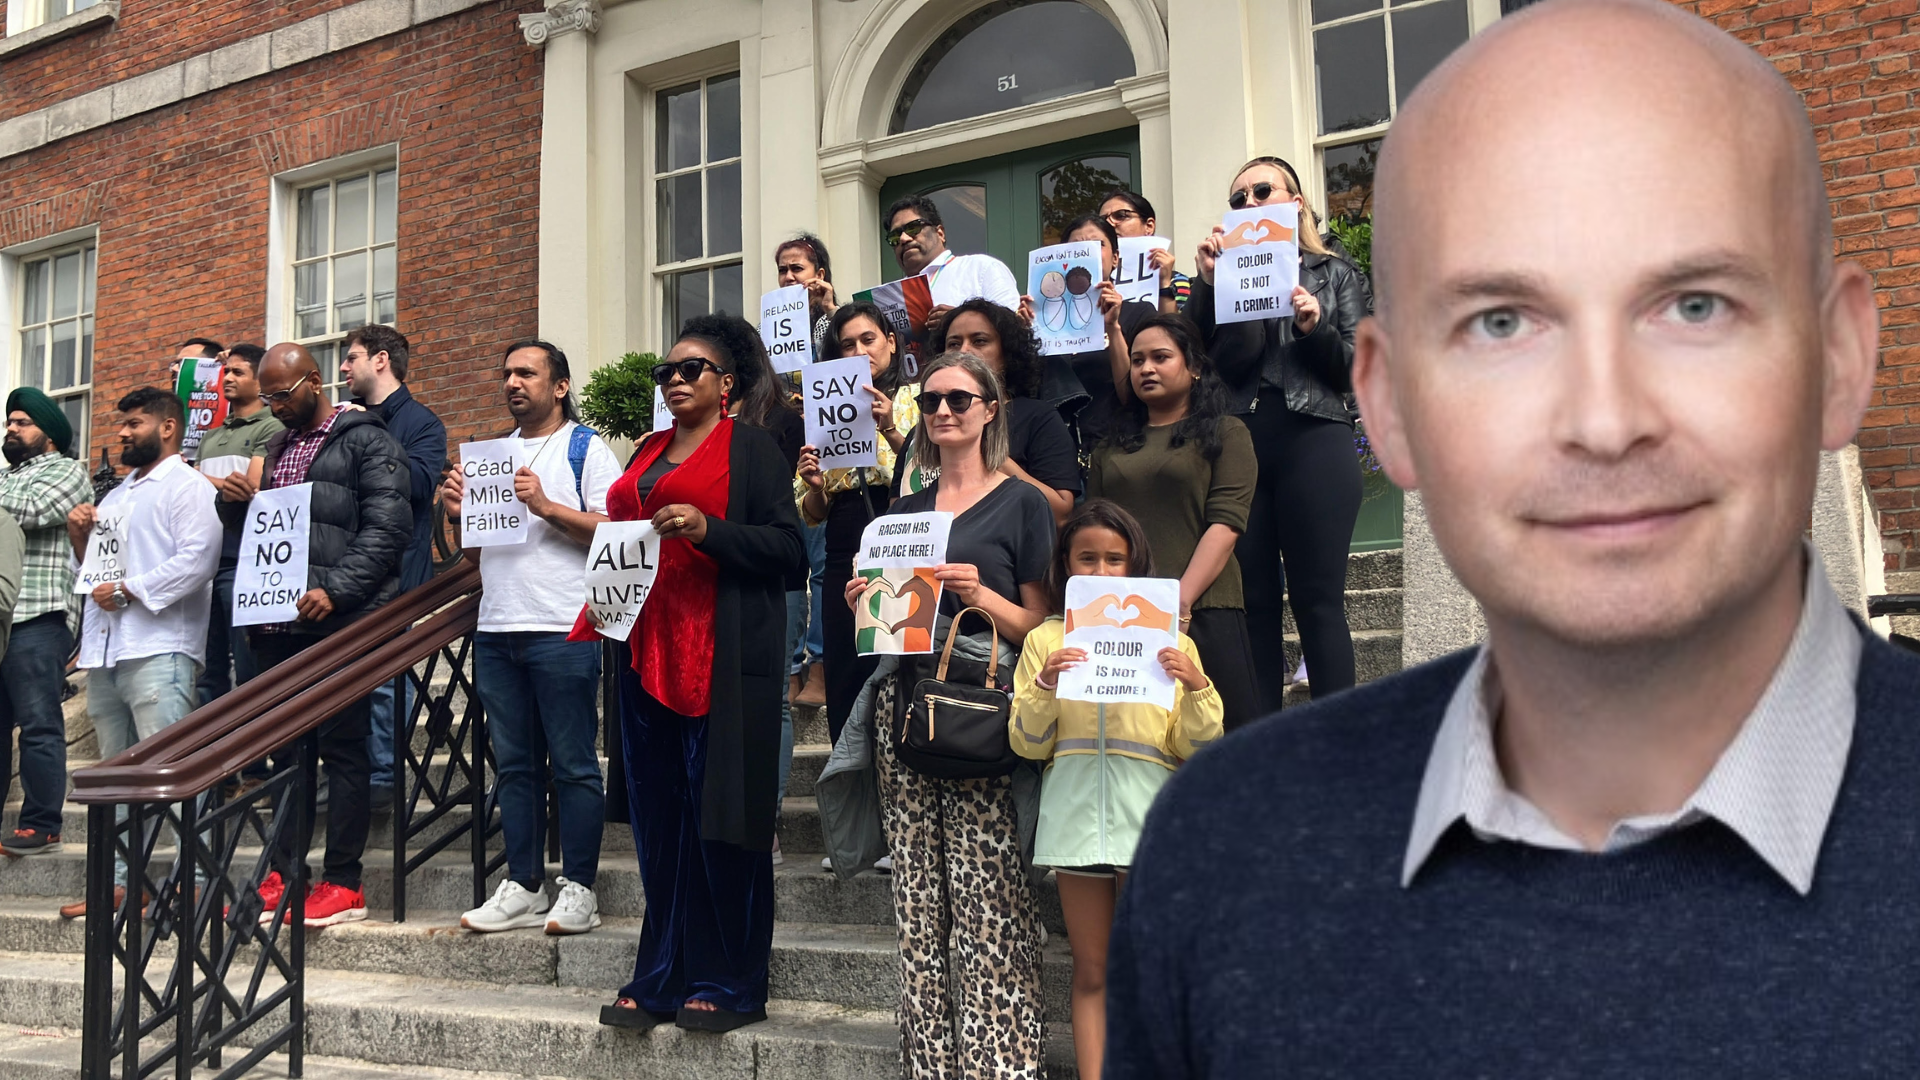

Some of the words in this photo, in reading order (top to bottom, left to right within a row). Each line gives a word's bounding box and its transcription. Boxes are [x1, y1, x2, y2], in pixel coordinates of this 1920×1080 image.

[997, 73, 1019, 92] 51
[1115, 252, 1154, 285] LL
[1237, 252, 1273, 269] COLOUR
[1240, 277, 1250, 290] IS
[1252, 275, 1270, 289] NOT
[763, 301, 805, 319] IRELAND
[891, 309, 906, 321] TOO
[1234, 300, 1241, 314] A
[773, 318, 793, 339] IS
[766, 339, 806, 357] HOME
[812, 374, 859, 400] SAY
[188, 400, 218, 409] MATTER
[189, 408, 213, 426] NO
[818, 403, 858, 427] NO
[827, 427, 853, 443] TO
[811, 440, 873, 459] RACISM
[463, 455, 514, 478] Céad
[470, 484, 513, 506] Míle
[96, 515, 124, 536] SAY
[254, 505, 300, 535] SAY
[466, 512, 520, 532] Fáilte
[878, 522, 912, 536] RACISM
[911, 521, 931, 534] HAS
[98, 538, 119, 557] NO
[255, 540, 293, 567] NO
[591, 540, 654, 571] ALL
[868, 546, 881, 559] NO
[881, 544, 907, 558] PLACE
[102, 558, 117, 570] TO
[83, 568, 127, 583] RACISM
[260, 571, 283, 588] TO
[237, 588, 301, 609] RACISM
[592, 583, 650, 605] LIVES
[1094, 640, 1143, 657] COLOUR
[1095, 664, 1108, 678] IS
[1111, 667, 1137, 678] NOT
[1084, 685, 1093, 694] A
